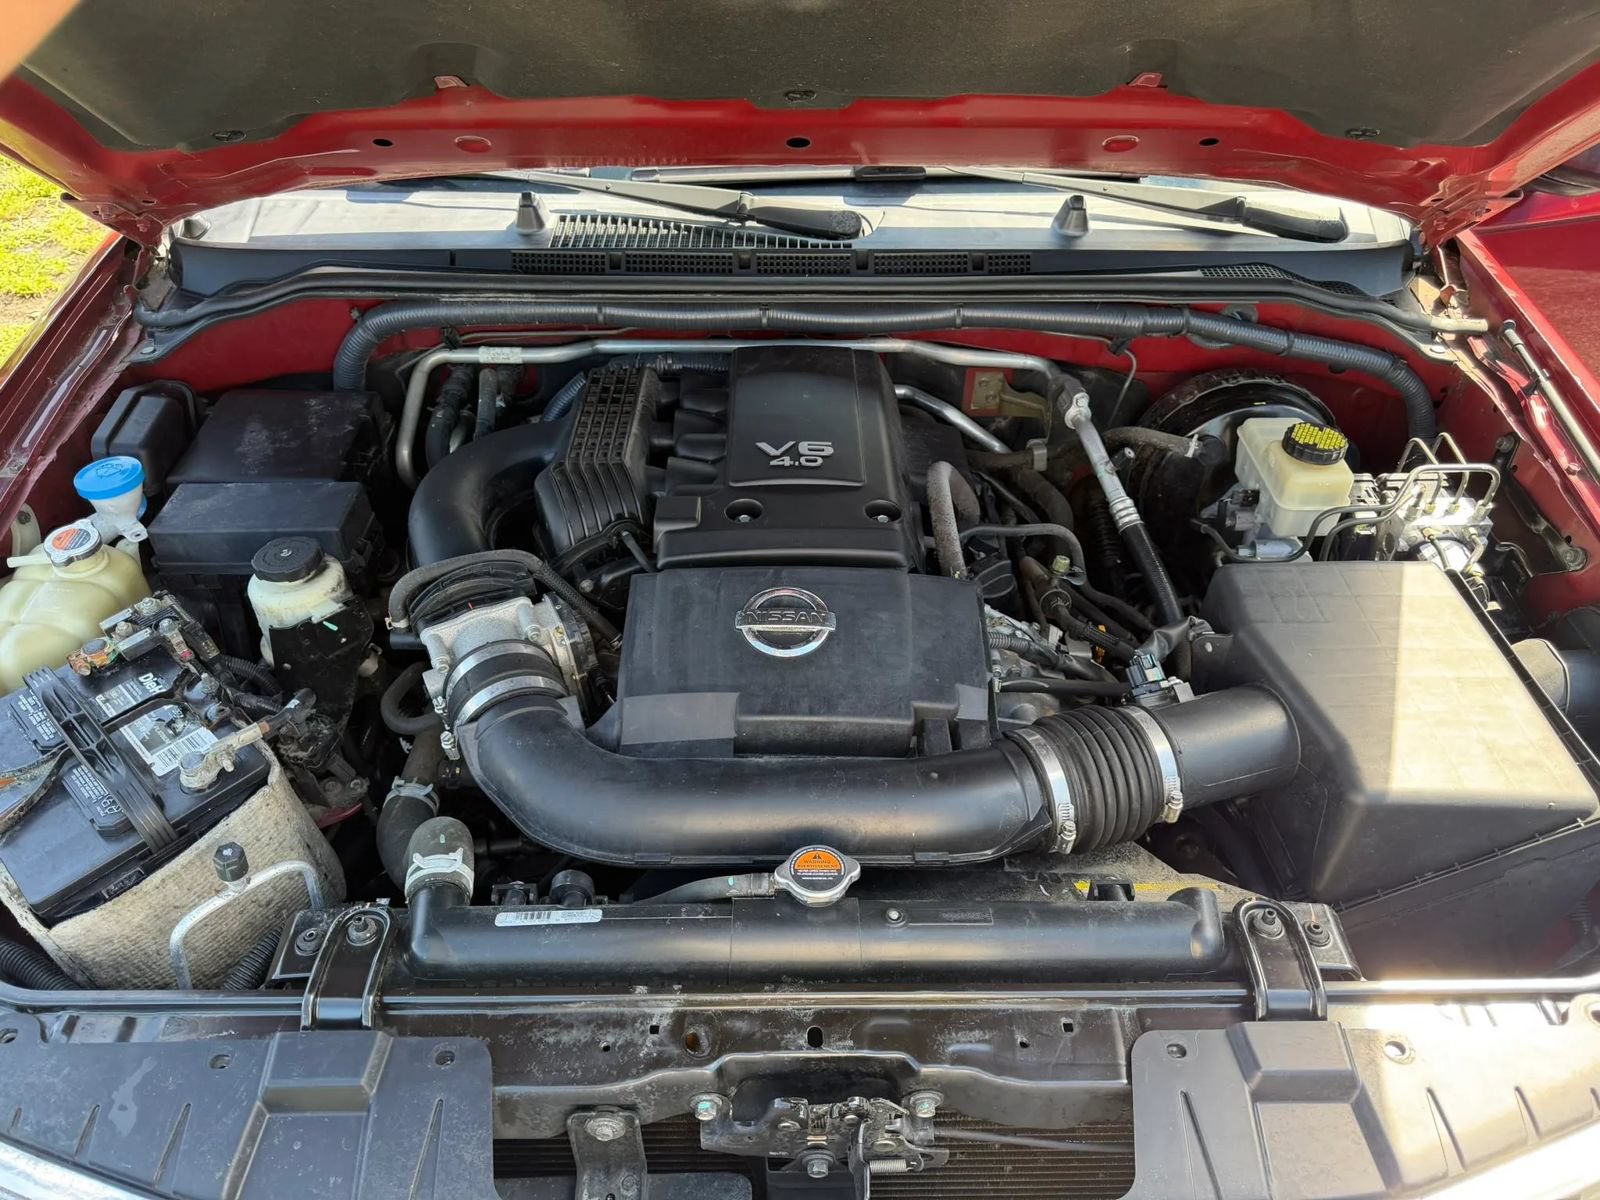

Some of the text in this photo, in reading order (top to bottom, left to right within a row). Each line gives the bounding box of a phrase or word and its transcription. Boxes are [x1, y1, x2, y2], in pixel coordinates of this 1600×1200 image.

[755, 440, 834, 457] V6
[769, 456, 823, 467] 4.0
[744, 610, 826, 623] NISSAN
[138, 672, 167, 696] DieH
